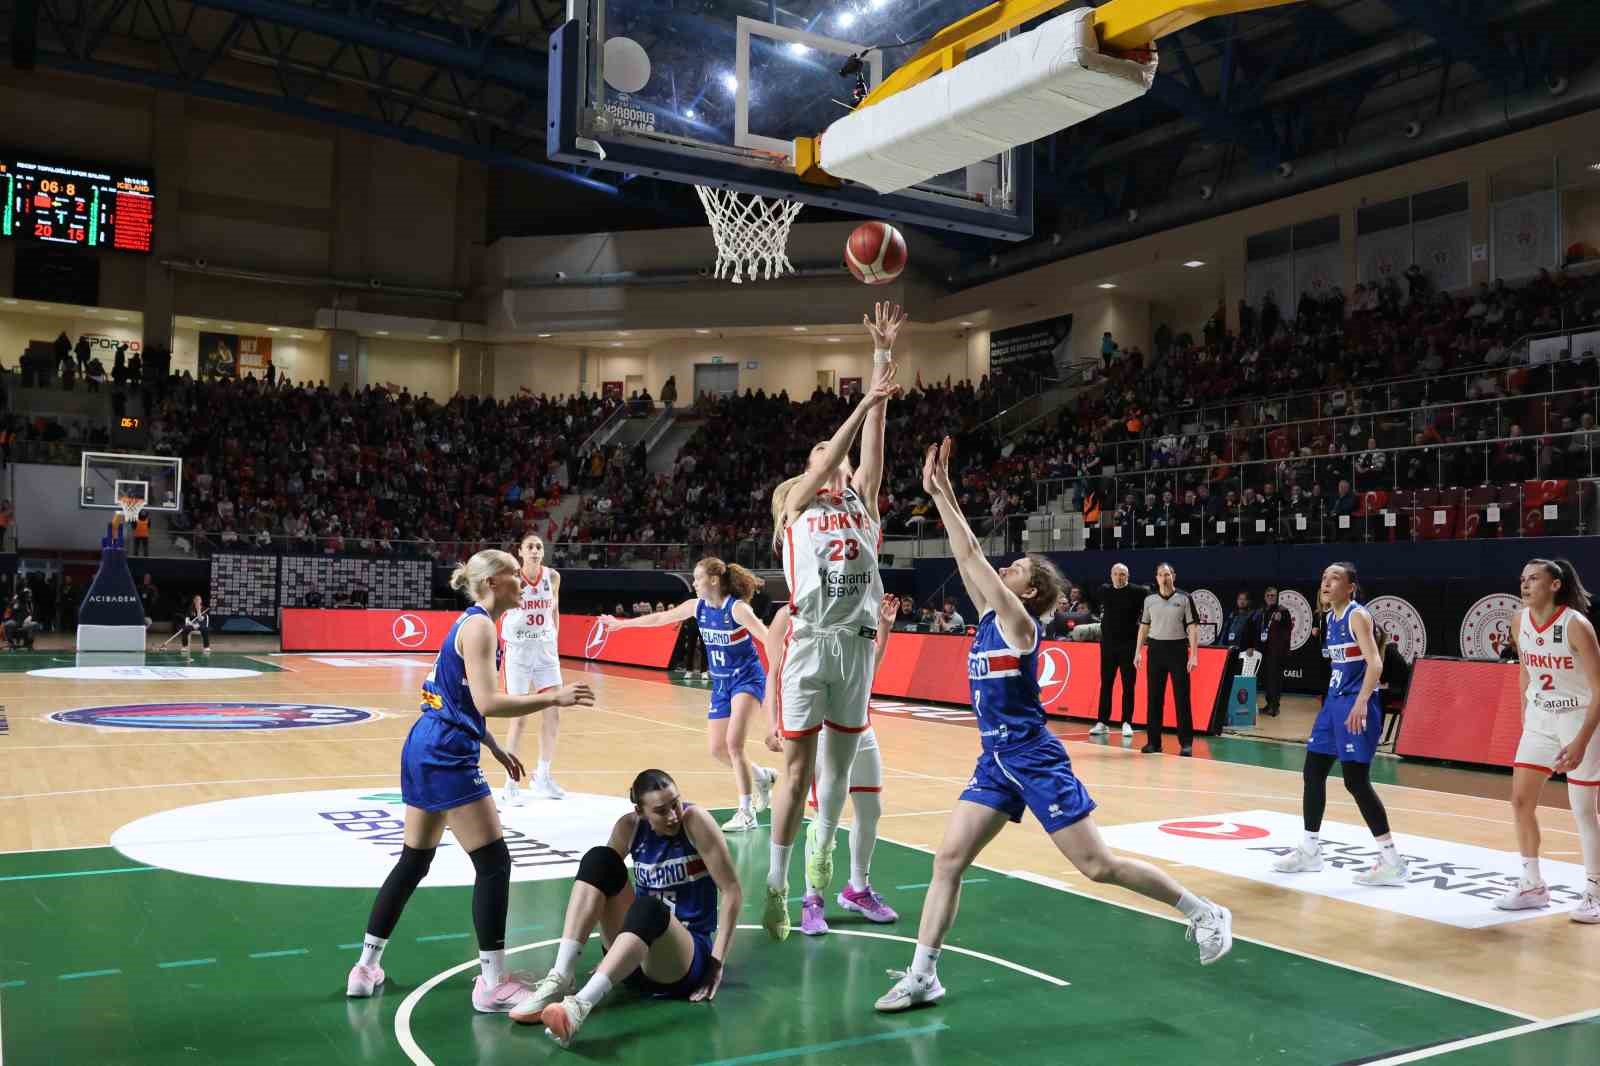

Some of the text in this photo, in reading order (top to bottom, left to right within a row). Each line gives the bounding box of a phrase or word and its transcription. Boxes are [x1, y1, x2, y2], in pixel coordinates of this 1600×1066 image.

[116, 182, 151, 193] ICELAND
[34, 223, 53, 237] 20
[829, 538, 859, 561] 23
[827, 570, 871, 584] Garanti
[828, 584, 859, 597] BBVA
[526, 614, 545, 626] 30
[711, 651, 725, 666] 14
[1539, 674, 1556, 691] 2
